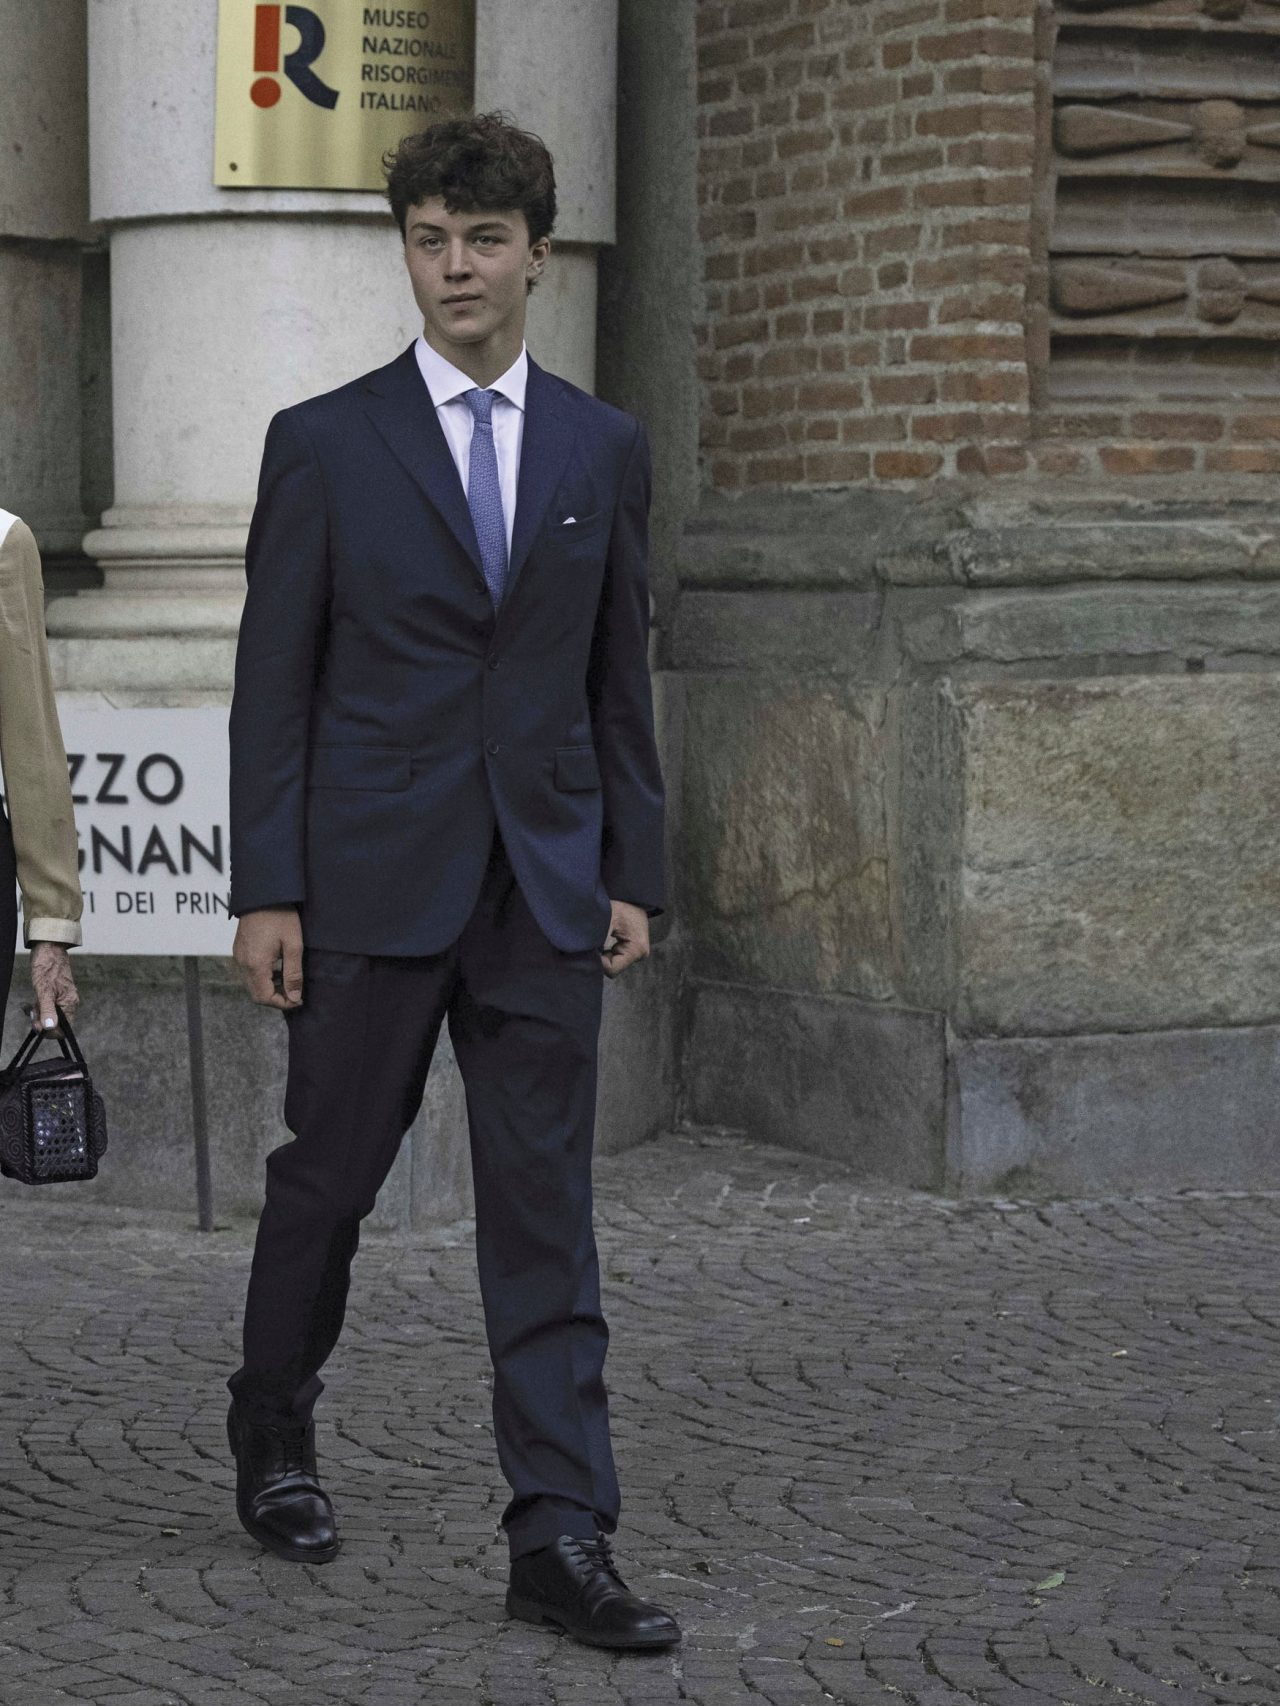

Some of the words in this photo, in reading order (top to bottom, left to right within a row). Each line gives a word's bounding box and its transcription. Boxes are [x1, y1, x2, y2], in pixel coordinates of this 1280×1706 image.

[363, 8, 430, 29] MUSEO
[362, 36, 456, 60] NAZIONALE
[360, 92, 441, 113] ITALIANO
[77, 824, 224, 876] NAN
[116, 891, 154, 914] DEI
[176, 891, 231, 914] PRIN
